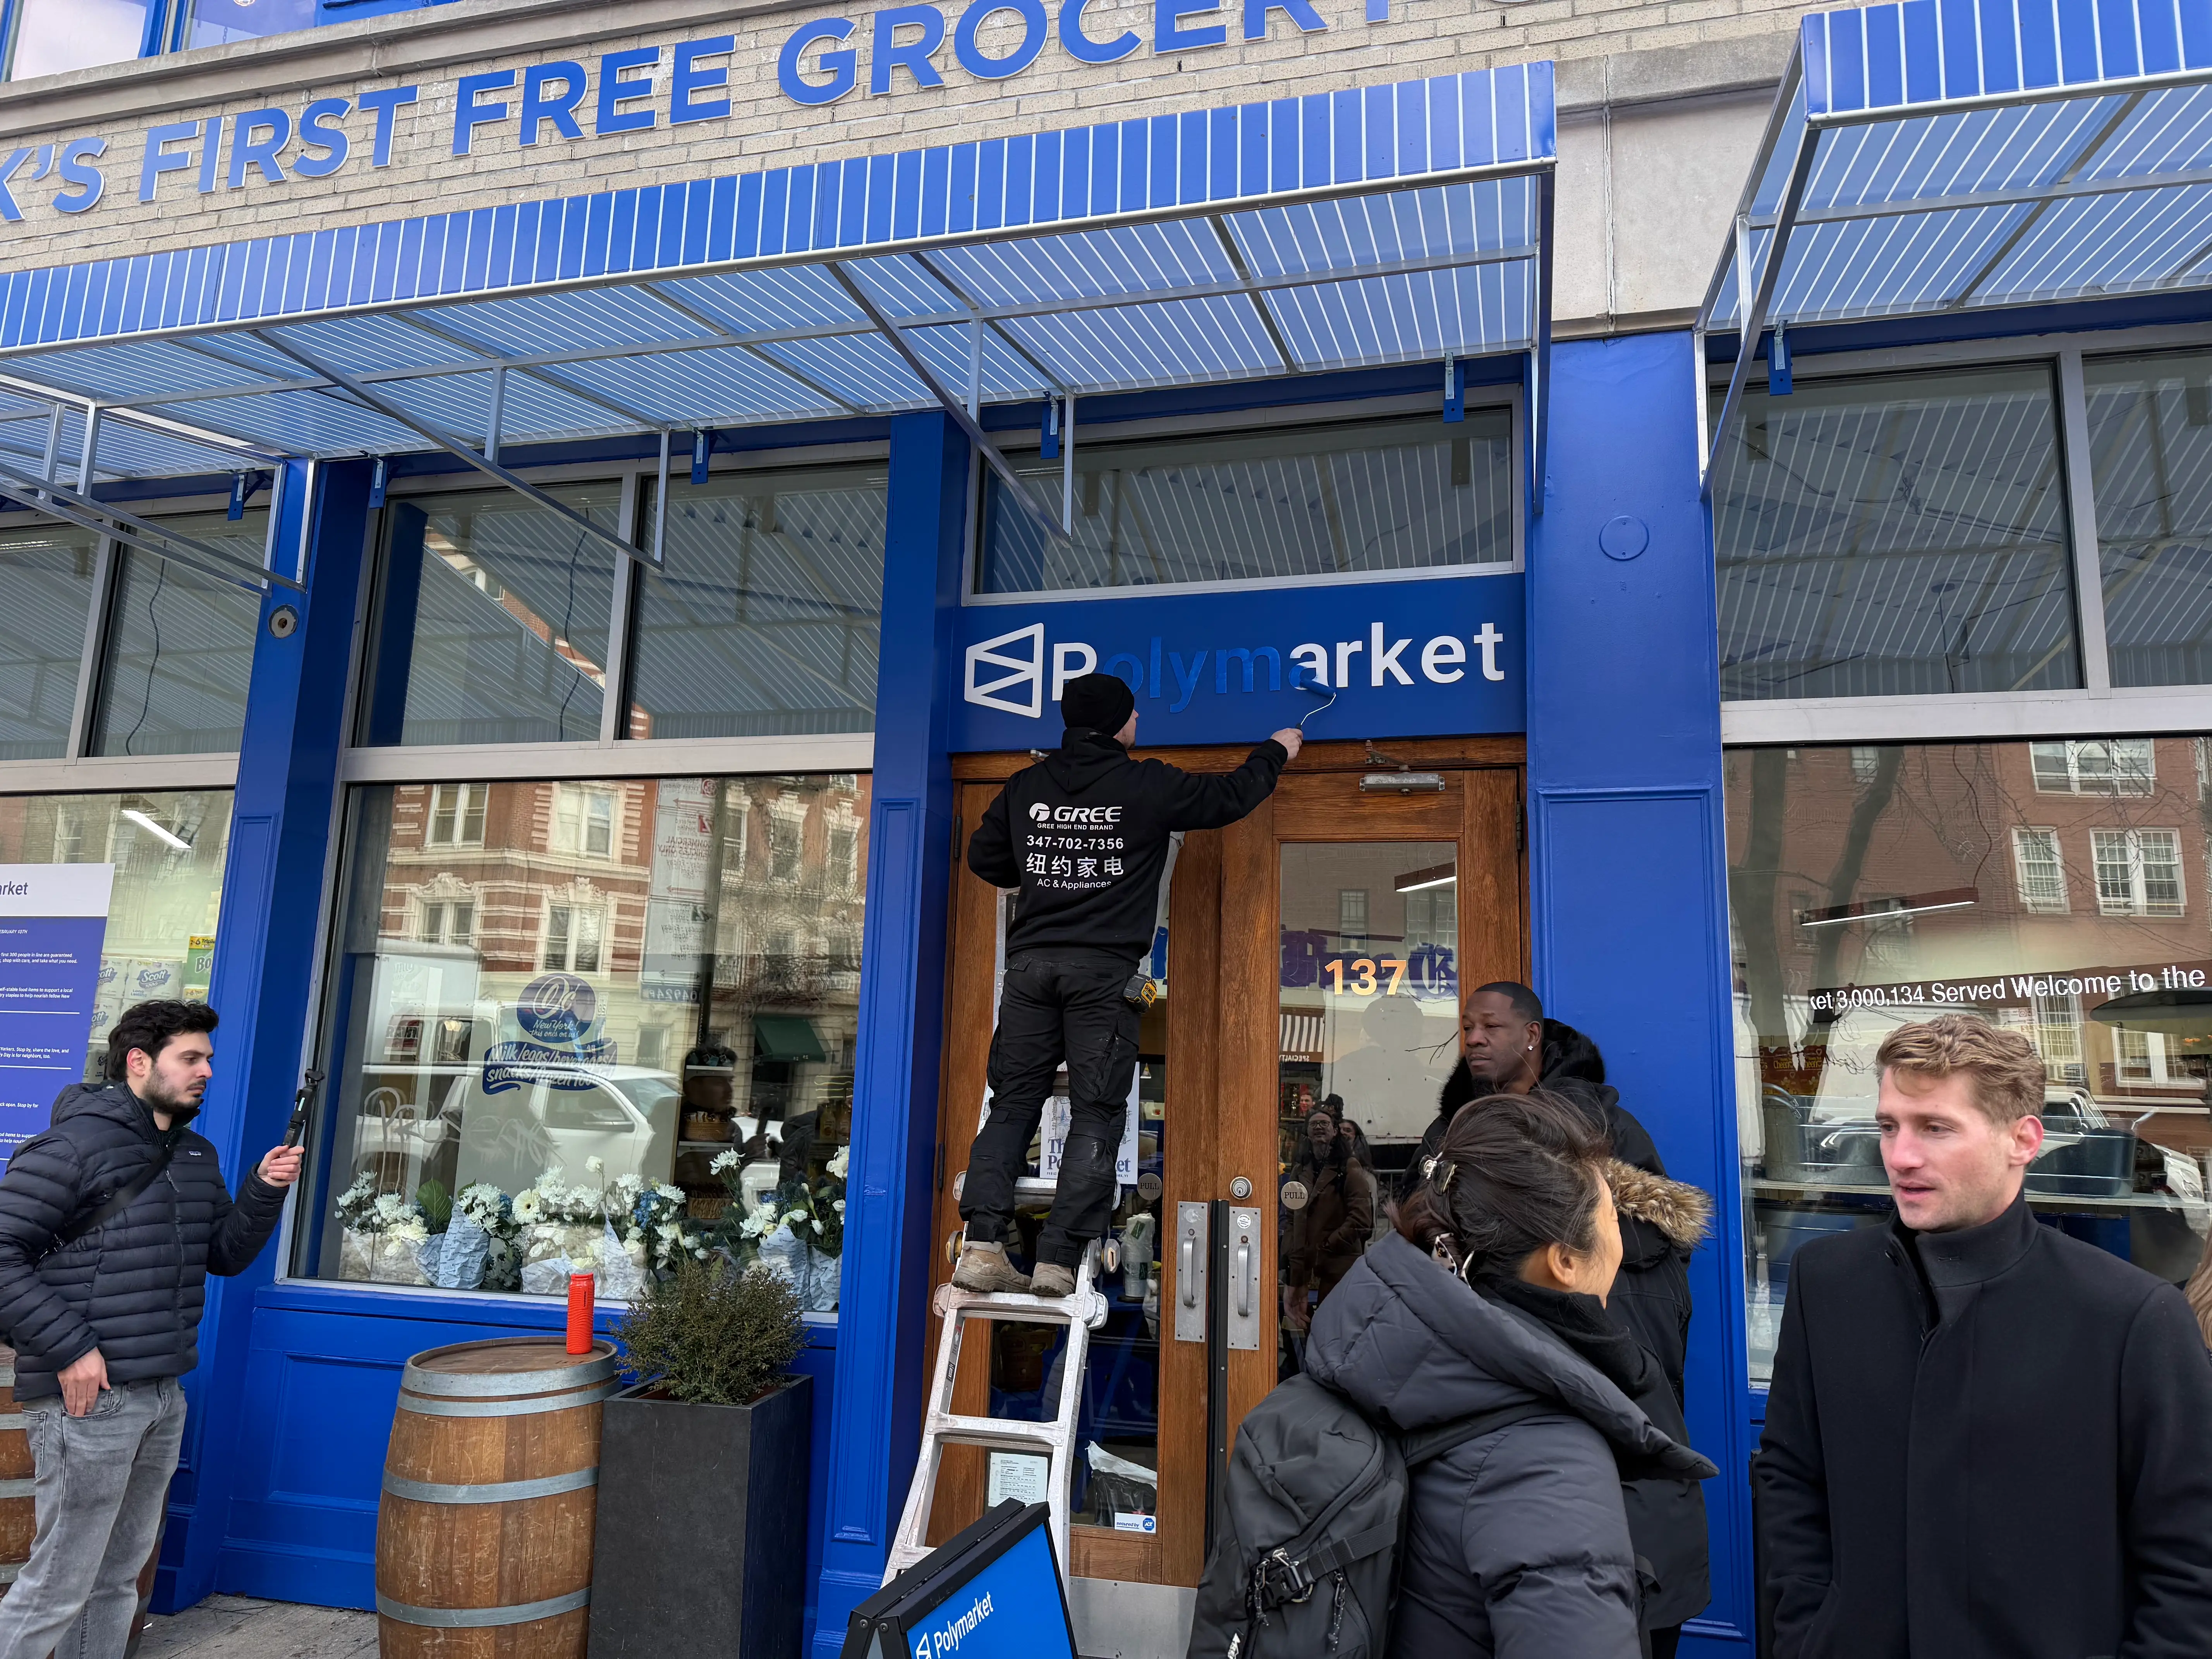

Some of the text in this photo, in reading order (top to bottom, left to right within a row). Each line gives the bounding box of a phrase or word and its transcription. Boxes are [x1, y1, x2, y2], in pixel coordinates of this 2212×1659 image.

[139, 84, 420, 203] FIRST
[452, 35, 736, 156] FREE
[778, 0, 1389, 105] GROCE
[1052, 622, 1505, 714] Polymarket
[1054, 806, 1122, 822] GREE
[1027, 835, 1123, 850] 347-702-7356
[1026, 852, 1124, 878] 纽约家电
[1037, 879, 1111, 890] AC & Appliances
[98, 968, 113, 978] ott
[141, 969, 166, 982] Scott
[1324, 958, 1407, 996] 137
[1837, 985, 1925, 1008] 3,000,134
[1932, 978, 2006, 1003] Served
[2010, 973, 2121, 998] Welcome
[2128, 970, 2154, 991] to
[2161, 965, 2205, 989] the
[529, 1029, 543, 1037] this
[533, 1019, 580, 1032] New York!
[1048, 1138, 1065, 1154] Th
[1284, 1191, 1305, 1200] PULL
[934, 1591, 994, 1659] Polymarket
